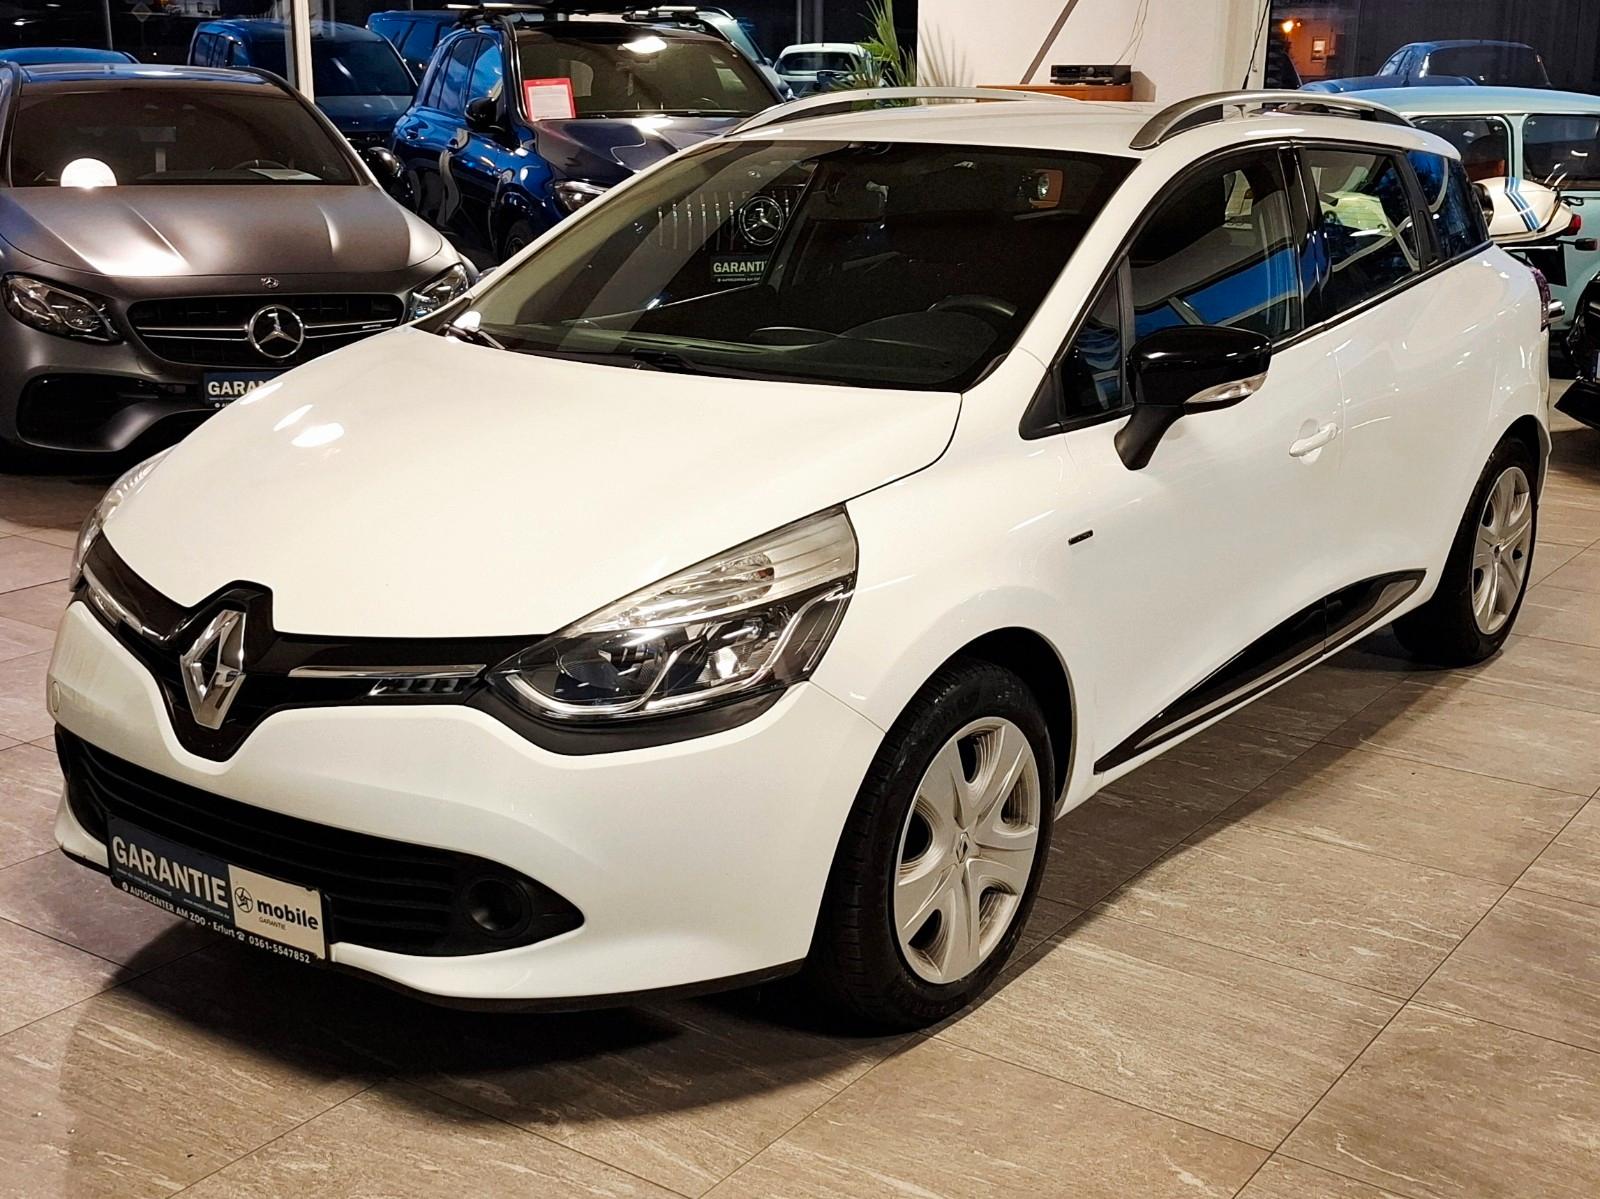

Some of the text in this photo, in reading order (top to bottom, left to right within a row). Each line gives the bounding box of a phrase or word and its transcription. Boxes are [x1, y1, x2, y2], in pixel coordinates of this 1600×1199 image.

[713, 260, 768, 273] GARANTI
[112, 835, 229, 909] GARANTIE
[130, 886, 175, 913] AUTOCENTER
[176, 906, 189, 919] AM
[190, 912, 206, 926] ZOO
[213, 921, 236, 938] Erfurt
[248, 935, 311, 964] 0361-5547852
[257, 899, 319, 930] mobile
[258, 916, 287, 931] GARANTIE
